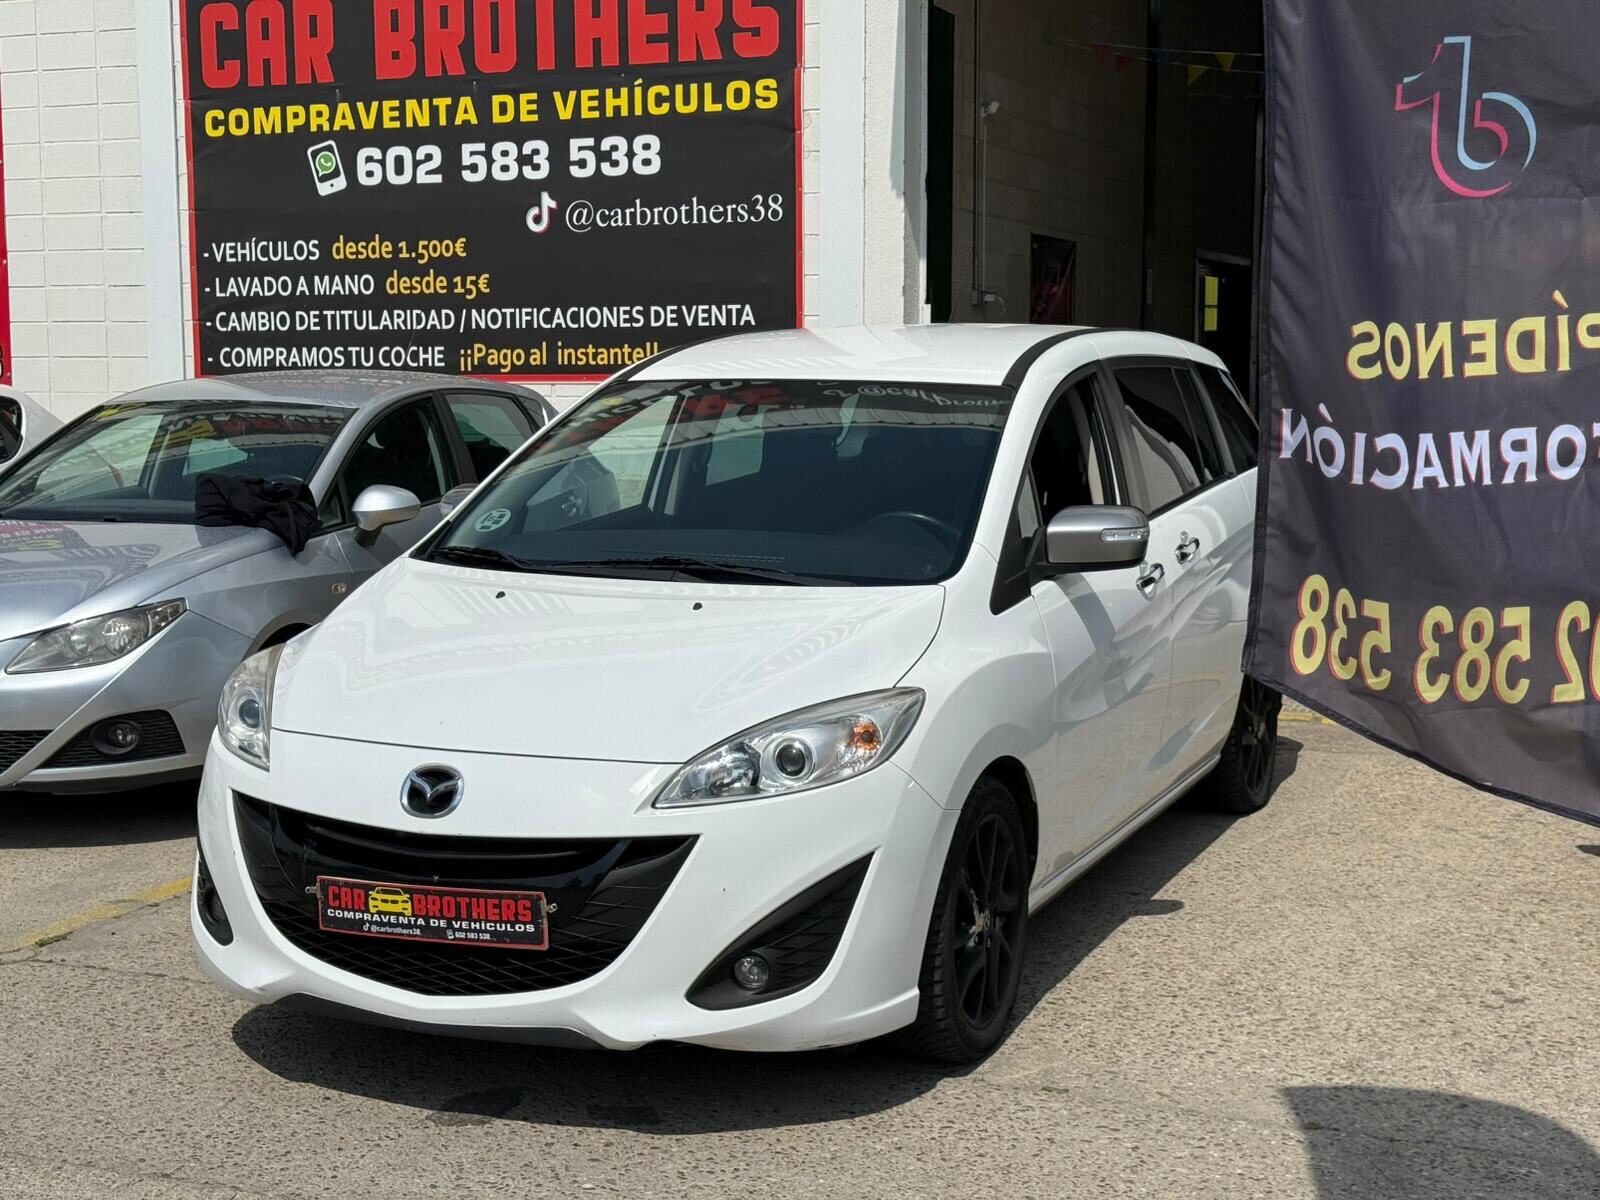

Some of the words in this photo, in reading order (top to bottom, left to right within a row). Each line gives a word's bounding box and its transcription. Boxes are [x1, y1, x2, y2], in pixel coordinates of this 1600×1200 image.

[200, 0, 335, 89] CAR
[204, 96, 478, 138] COMPRAVENTA
[491, 92, 539, 124] DE
[553, 78, 778, 120] VEHÍCULOS
[356, 144, 443, 187] 602
[461, 140, 550, 182] 583
[569, 134, 662, 178] 538
[565, 193, 784, 233] @carbrothers38
[212, 238, 320, 263] VEHÍCULOS
[332, 234, 393, 260] desde
[398, 238, 467, 264] 1.500€
[215, 276, 292, 298] LAVADO
[296, 275, 310, 296] A
[314, 274, 375, 296] MANO
[385, 269, 448, 295] desde
[453, 273, 490, 300] 15€
[215, 311, 291, 331] CAMBIO
[295, 311, 320, 330] DE
[323, 309, 455, 331] TITULARIDAD
[471, 306, 645, 330] NOTIFICACIONES
[650, 305, 678, 327] DE
[681, 304, 756, 327] VENTA
[219, 347, 345, 368] COMPRAMOS
[348, 346, 374, 367] TU
[378, 346, 445, 367] COCHE
[459, 343, 526, 373] ¡¡Pago
[530, 342, 547, 365] al
[327, 908, 426, 926] COMPRAVENTA
[430, 918, 448, 928] DE
[452, 920, 535, 932] VEHÍCULOS
[328, 885, 366, 910] CAR
[412, 894, 532, 922] BROTHERS
